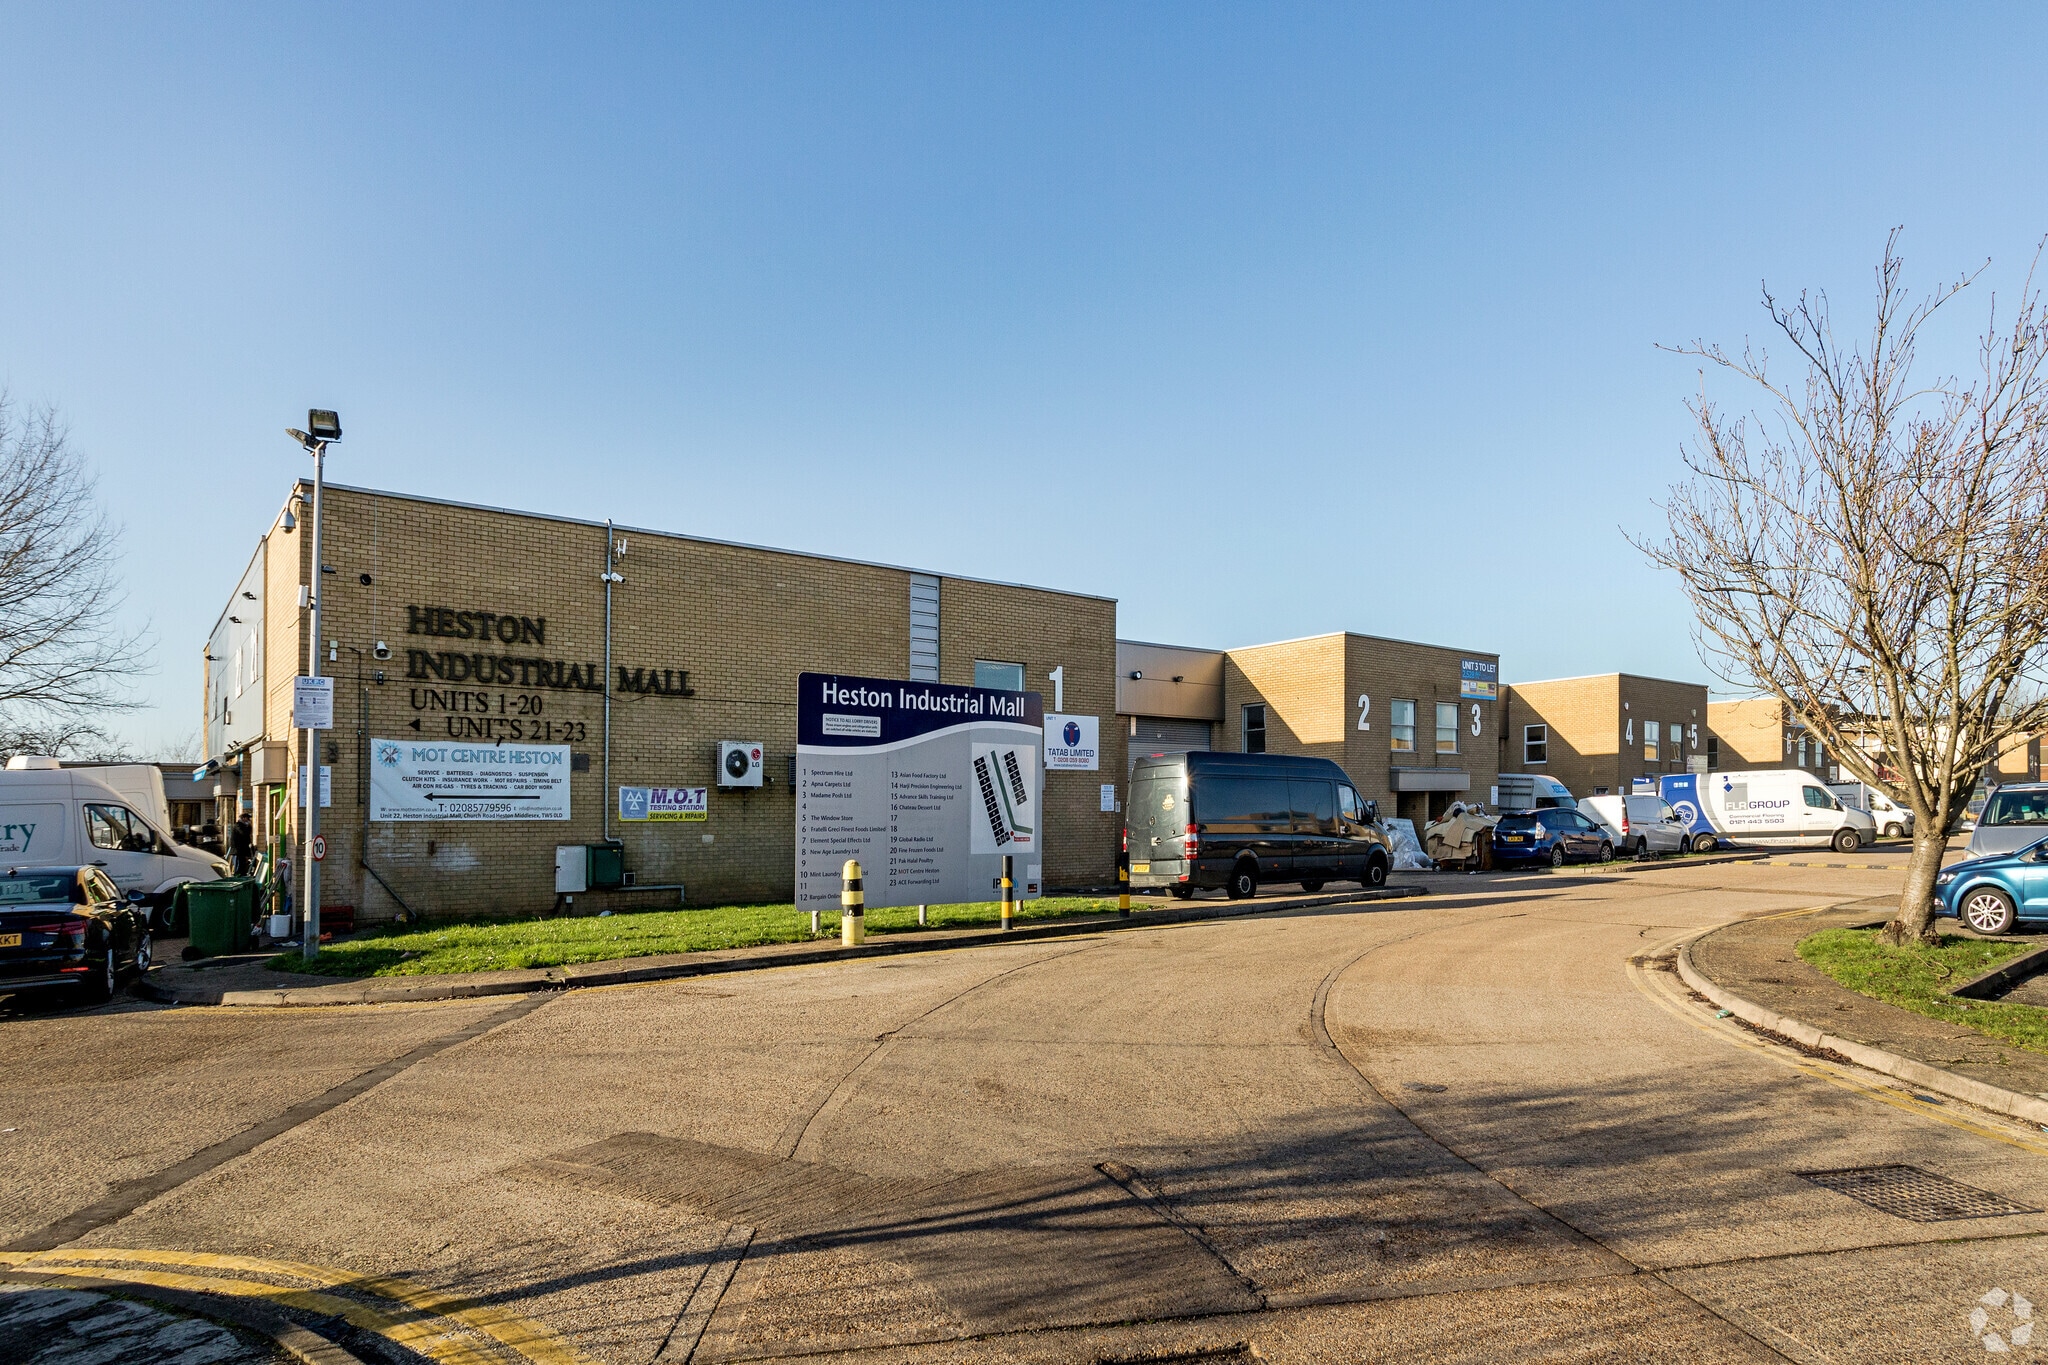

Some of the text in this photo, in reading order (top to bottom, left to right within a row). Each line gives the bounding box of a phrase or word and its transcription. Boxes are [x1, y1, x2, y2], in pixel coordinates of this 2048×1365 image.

[407, 605, 545, 644] HESTON
[407, 649, 694, 696] INDUSTRIAL MALL
[1462, 661, 1496, 673] UNIT 3 TO LET
[410, 688, 543, 715] UNITS 1-20
[822, 682, 1024, 717] Heston Industrial Mall
[1049, 666, 1063, 712] 1
[1357, 694, 1370, 731] 2
[1472, 703, 1482, 737] 3
[446, 716, 587, 742] UNITS 21-23
[1626, 718, 1634, 746] 4
[1691, 724, 1698, 750] 5
[412, 748, 562, 765] MOT CENTRE HESTON
[1048, 748, 1095, 757] TATAB LIMITED
[1786, 732, 1792, 755] 6
[438, 804, 447, 813] T:
[450, 804, 512, 813] 02085779596
[651, 789, 706, 805] M.O.T
[1726, 800, 1790, 810] FLR GROUP
[315, 842, 324, 854] 10
